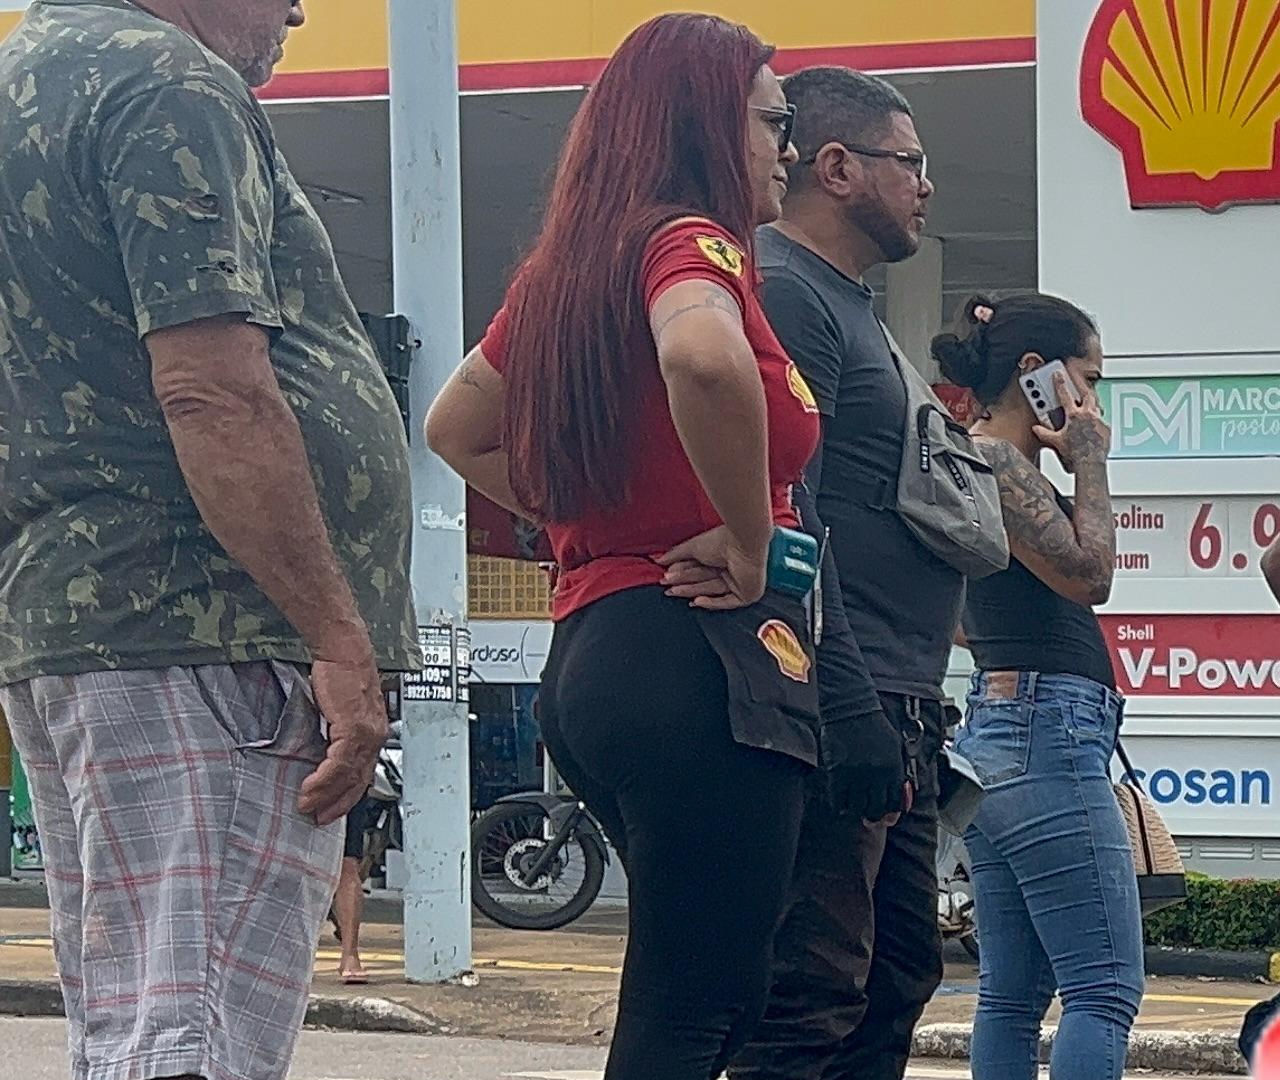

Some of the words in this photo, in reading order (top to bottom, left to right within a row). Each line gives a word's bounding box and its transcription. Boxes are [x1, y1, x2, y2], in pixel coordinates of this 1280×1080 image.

[1112, 503, 1164, 529] solina
[1115, 553, 1149, 570] mum
[1117, 624, 1154, 641] Shell
[469, 645, 520, 662] rdoso
